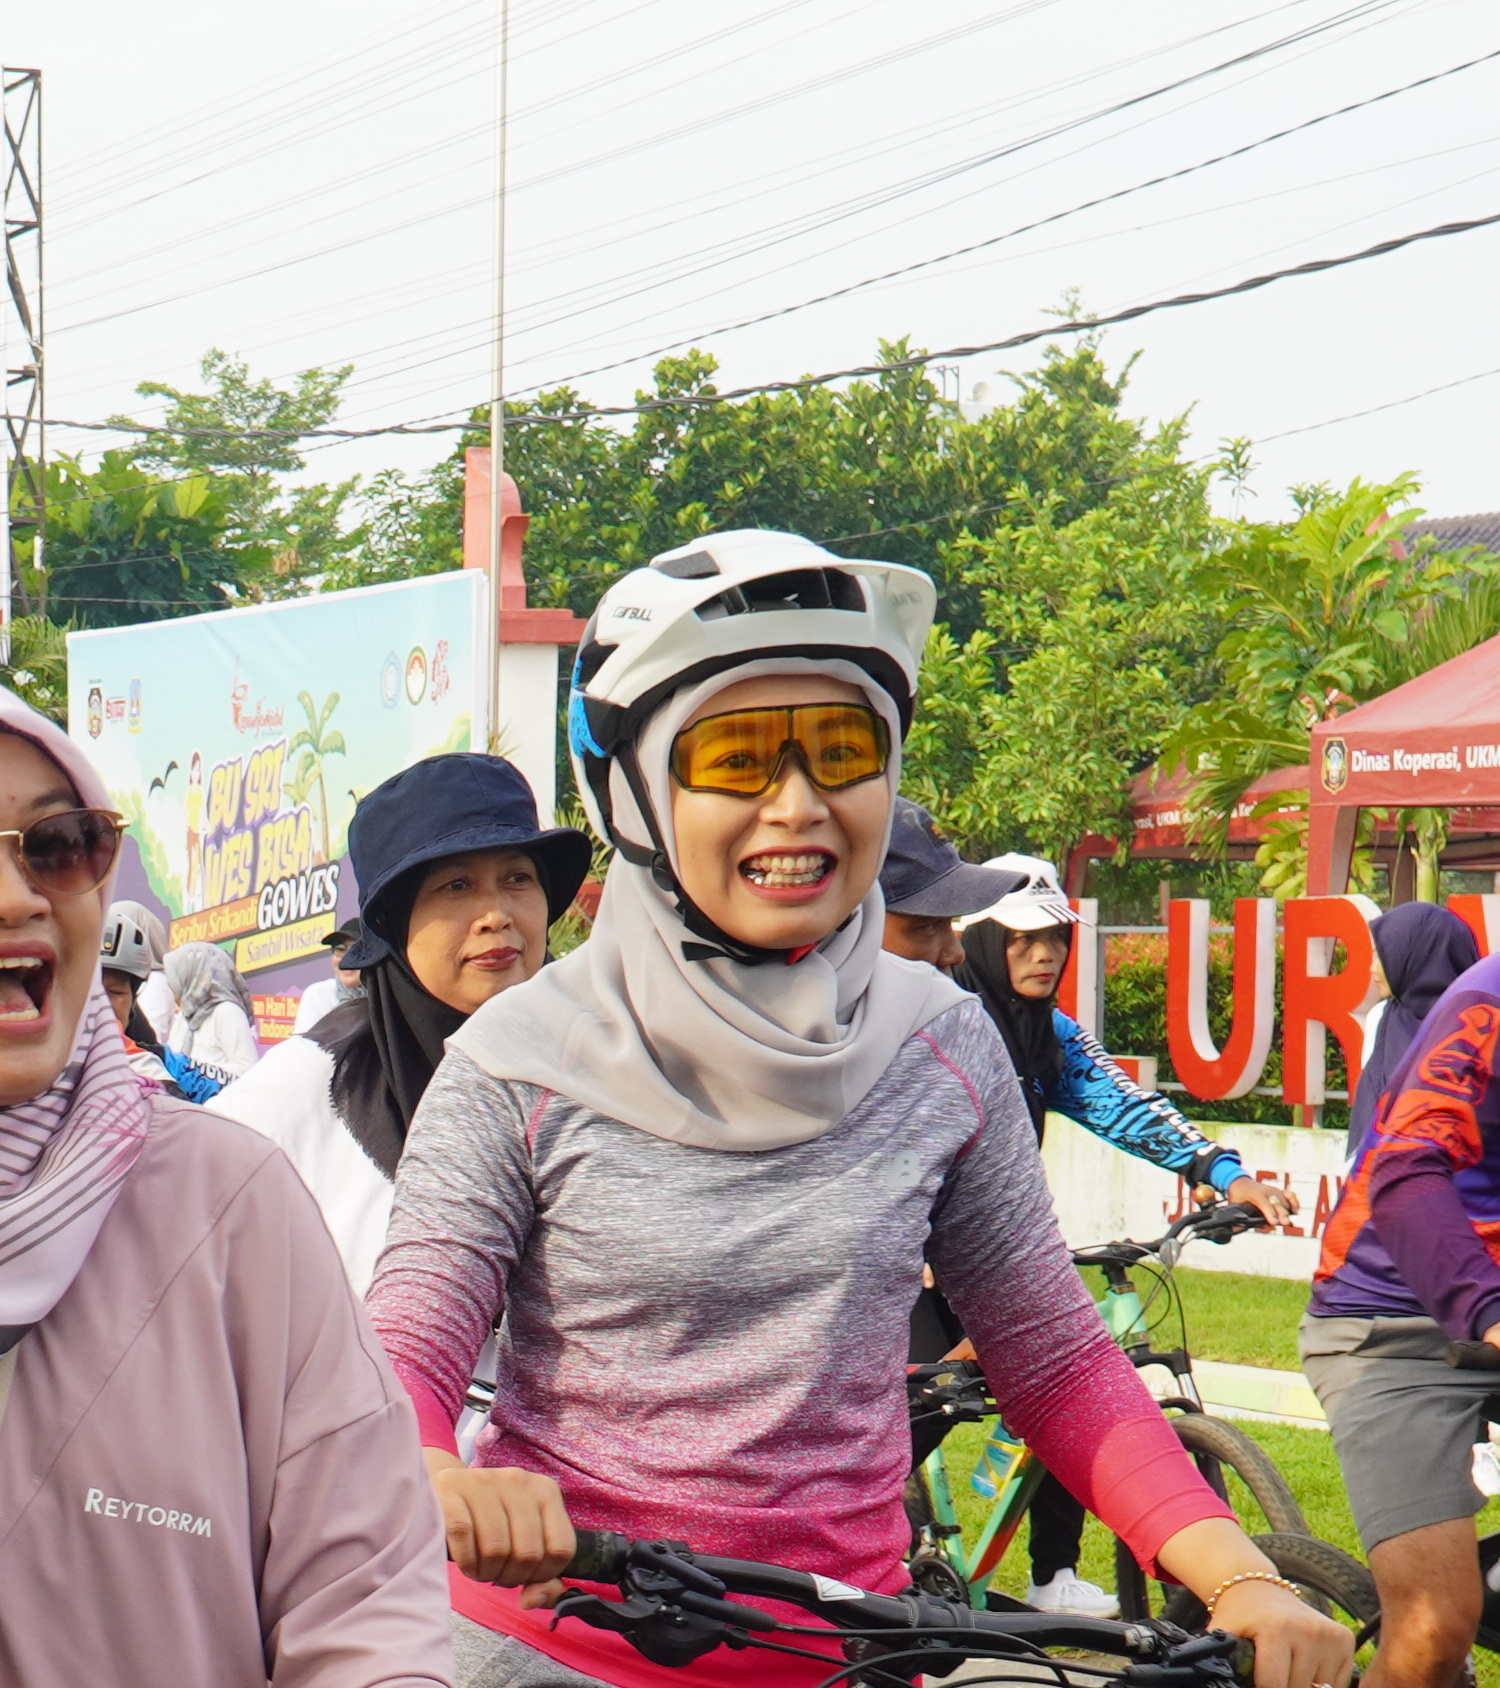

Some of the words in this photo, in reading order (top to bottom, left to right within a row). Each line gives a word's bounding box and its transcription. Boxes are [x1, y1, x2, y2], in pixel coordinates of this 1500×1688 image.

[208, 757, 242, 839] BU
[244, 739, 286, 826] SRI
[1351, 750, 1391, 773] Dinas
[1394, 747, 1462, 776] Koperasi,
[204, 829, 253, 908] WES
[170, 917, 207, 950] Seribu
[208, 902, 258, 937] Srikandi
[257, 862, 341, 931] GOWES
[246, 934, 283, 964] Sambil
[284, 925, 326, 954] Wisata
[266, 996, 286, 1017] Hari
